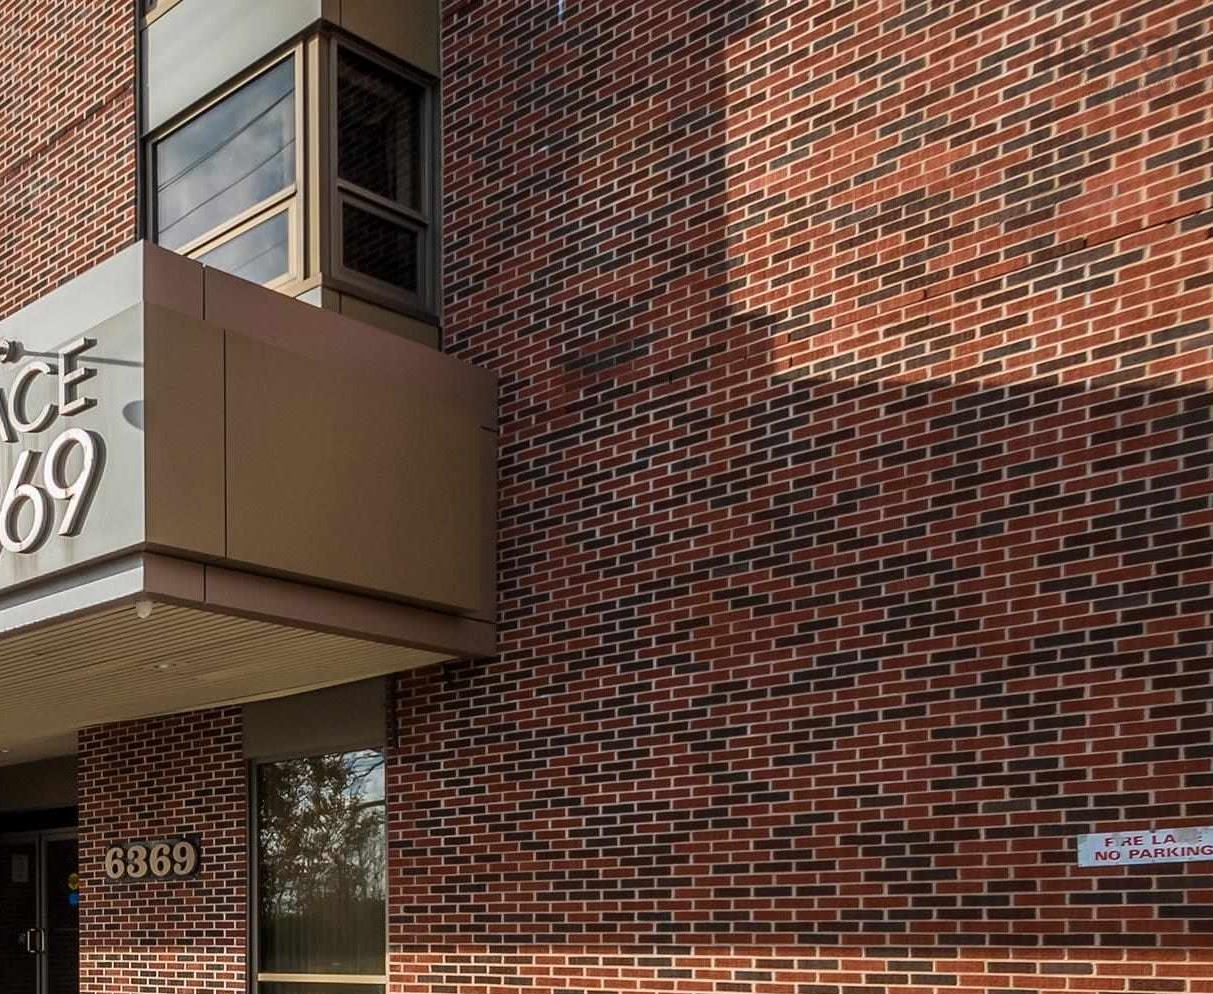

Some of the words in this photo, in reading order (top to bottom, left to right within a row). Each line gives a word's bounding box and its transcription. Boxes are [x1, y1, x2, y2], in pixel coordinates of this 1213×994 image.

[1104, 836, 1144, 847] FRE
[105, 841, 195, 879] 6369
[1095, 850, 1121, 861] NO
[1128, 845, 1213, 859] PARKING
